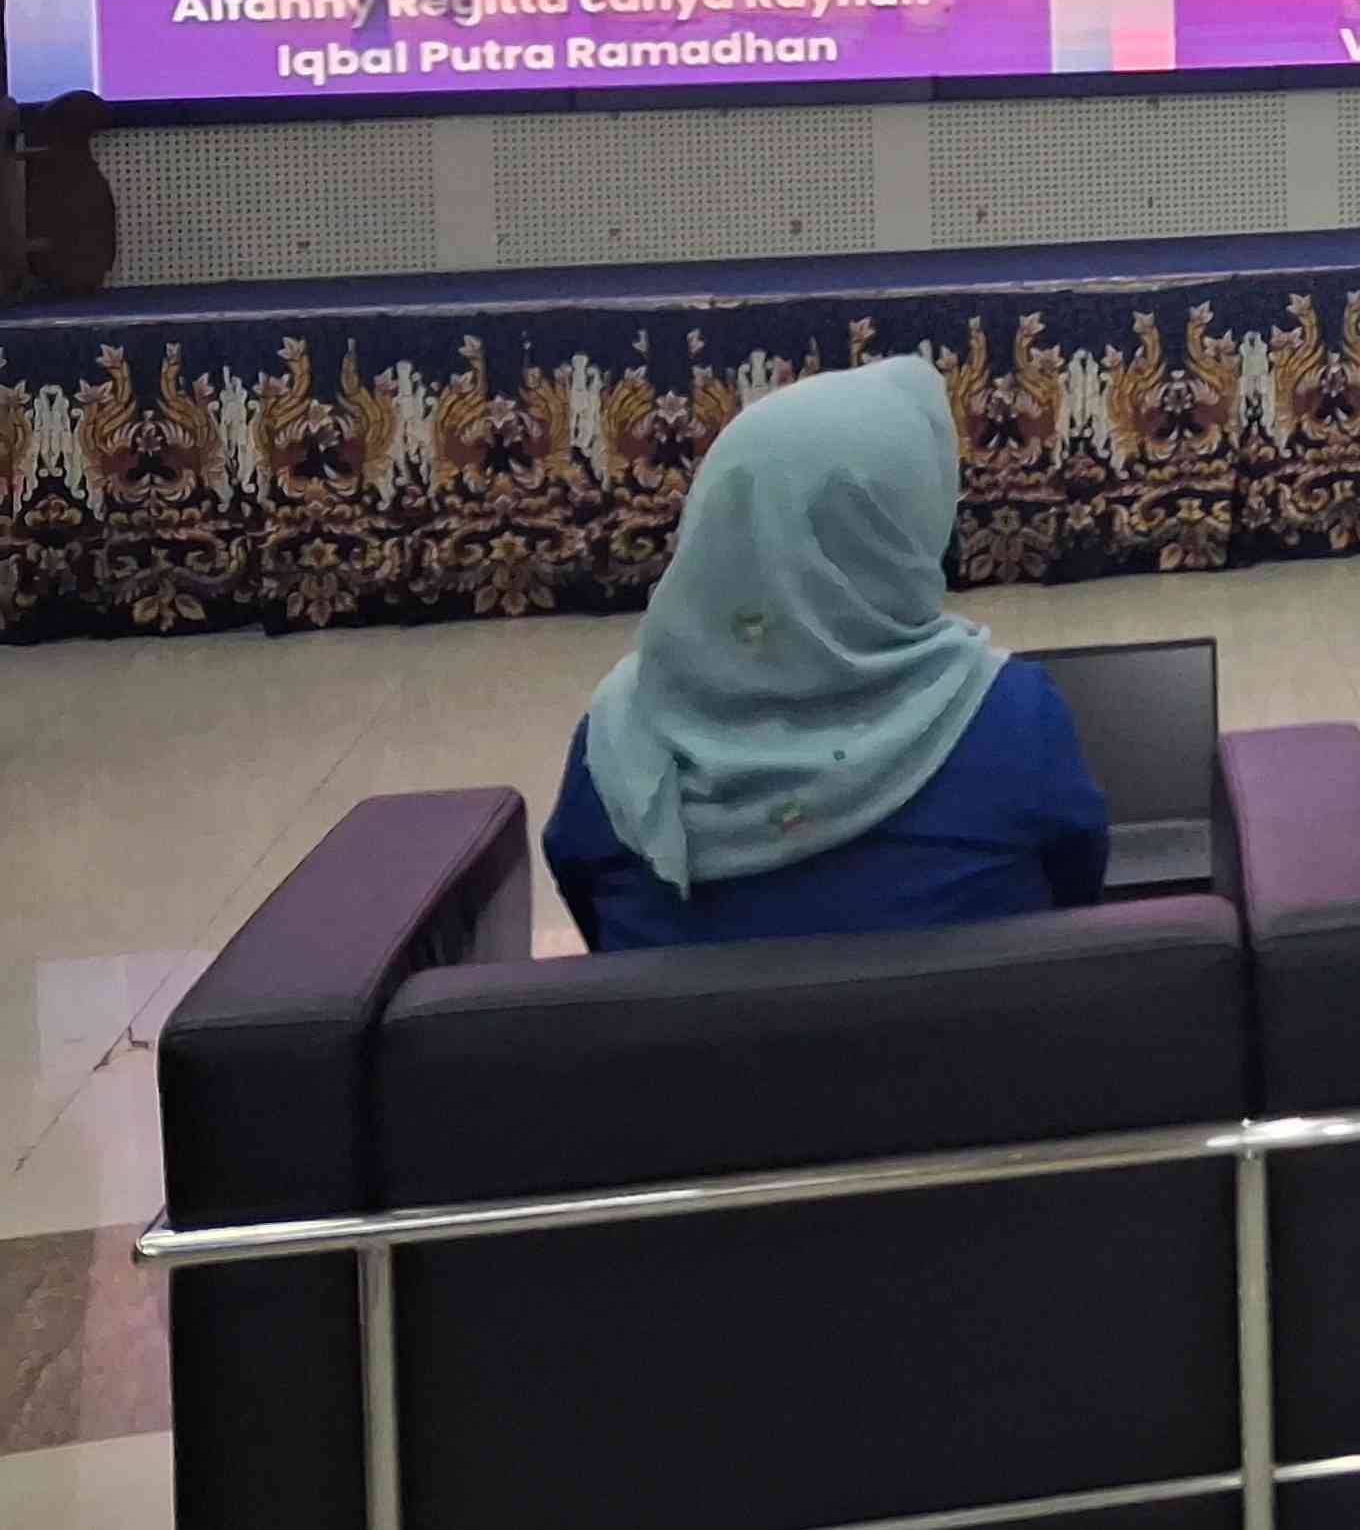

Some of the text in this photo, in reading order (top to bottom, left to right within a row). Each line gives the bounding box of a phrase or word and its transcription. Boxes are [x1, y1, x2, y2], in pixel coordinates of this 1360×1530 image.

[277, 32, 838, 87] Iqbal Putra Ramadhan
